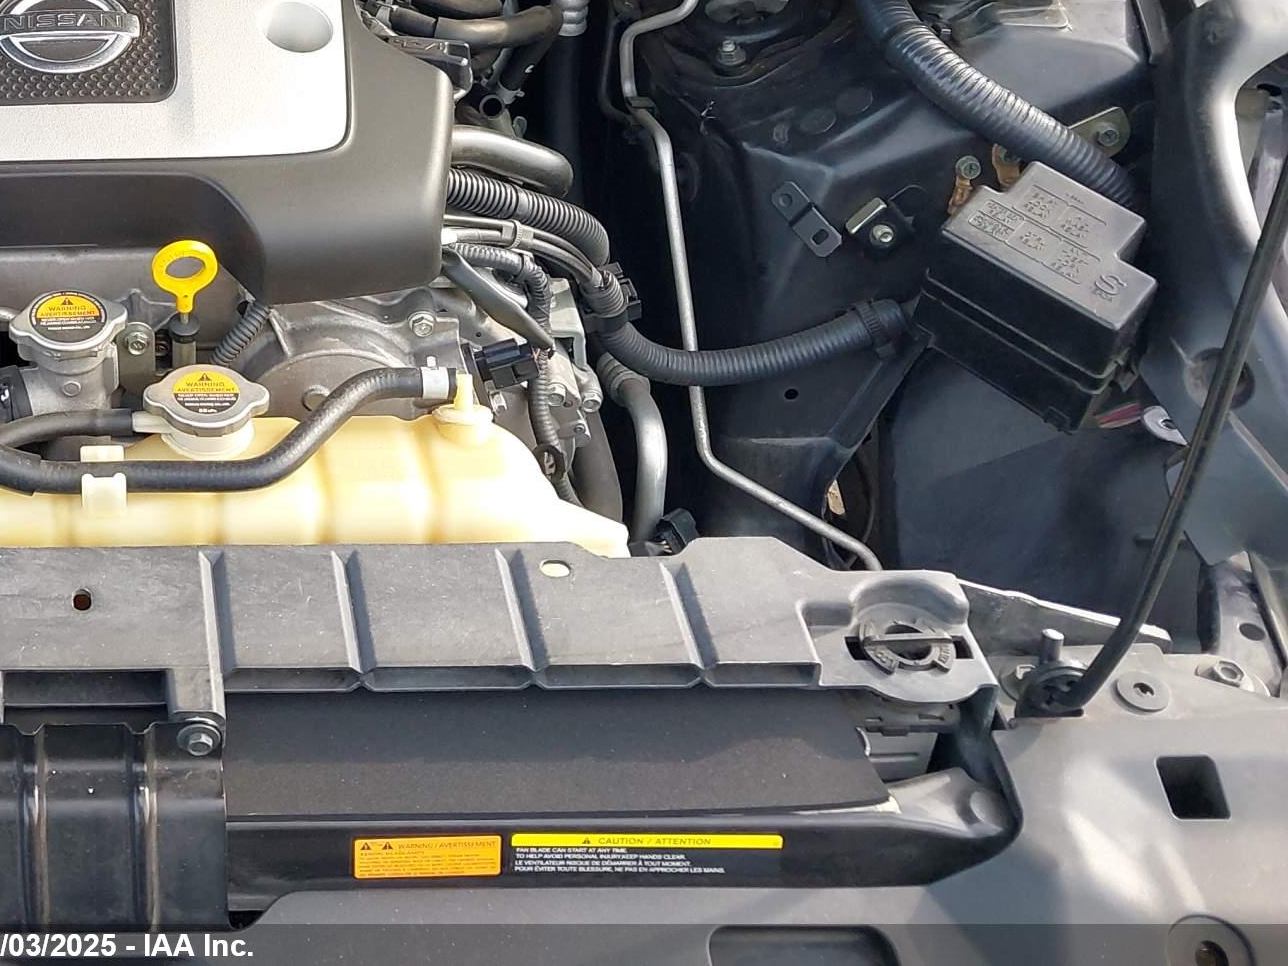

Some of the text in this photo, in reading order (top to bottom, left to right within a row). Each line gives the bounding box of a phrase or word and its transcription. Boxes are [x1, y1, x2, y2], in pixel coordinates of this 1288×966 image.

[3, 12, 123, 31] NISSAN
[398, 842, 433, 851] WARNING
[439, 840, 497, 849] AVERTISSEMENT
[598, 837, 644, 845] CAUTION
[655, 837, 712, 845] ATTENTION
